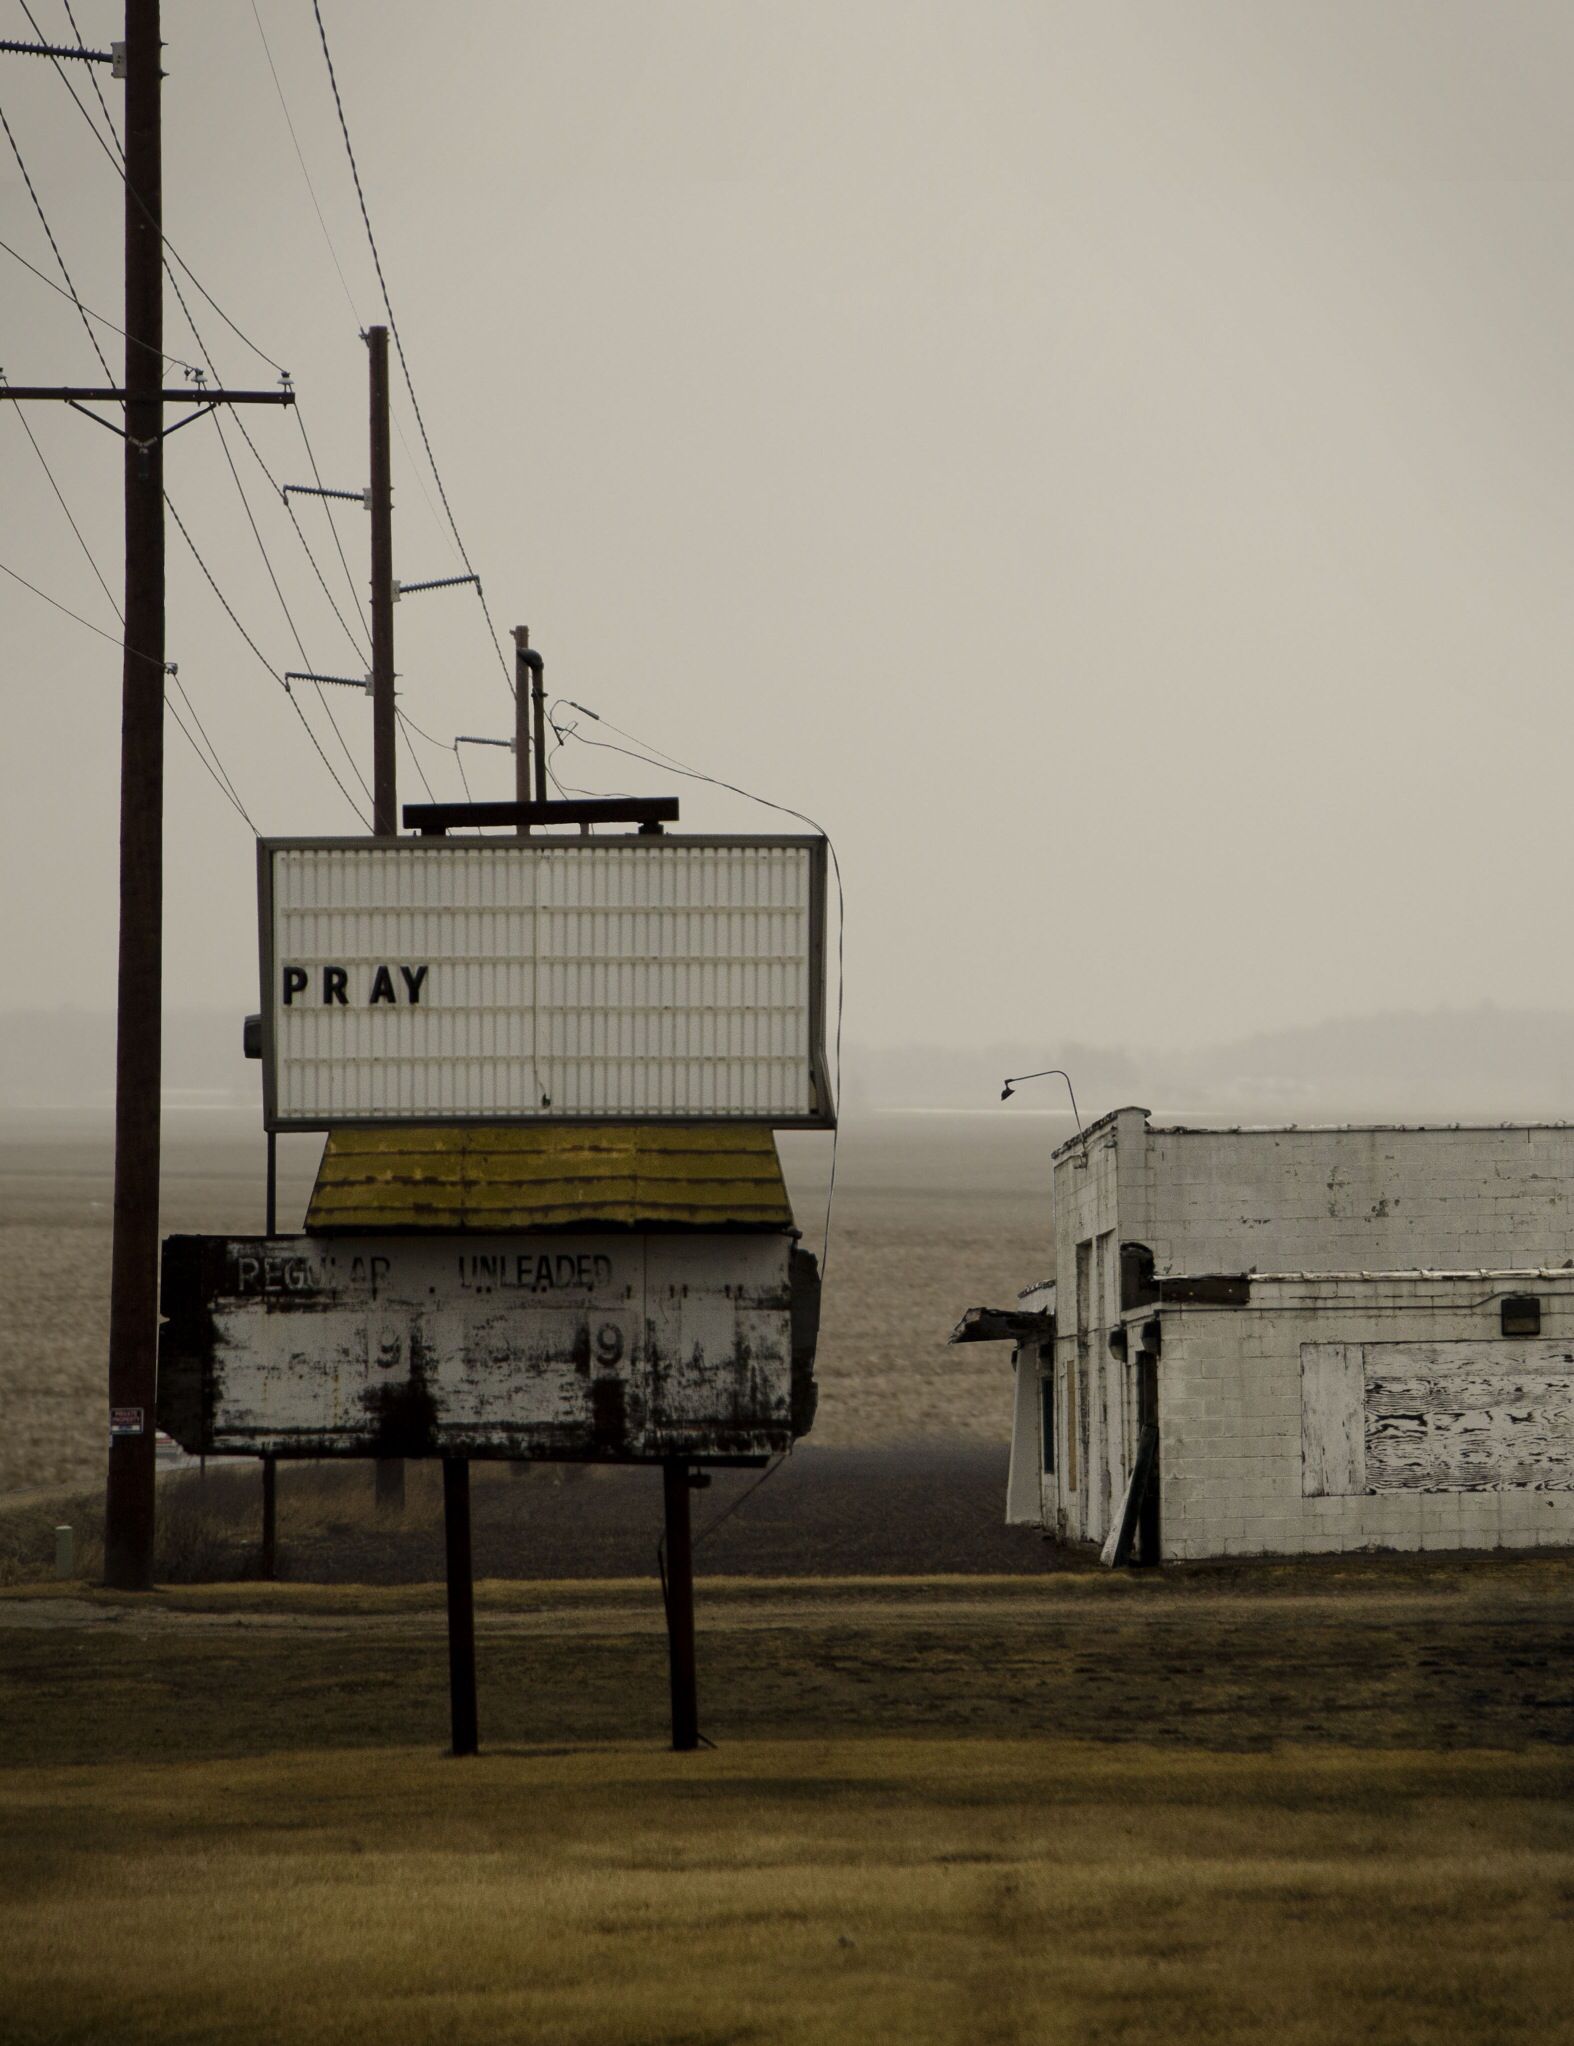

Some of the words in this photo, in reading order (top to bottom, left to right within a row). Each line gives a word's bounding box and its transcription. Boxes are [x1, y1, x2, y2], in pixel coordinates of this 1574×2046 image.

[283, 965, 428, 1005] PRAY
[238, 1257, 390, 1291] REGUAR
[459, 1255, 613, 1288] UNLEADED
[597, 1322, 624, 1367] 9
